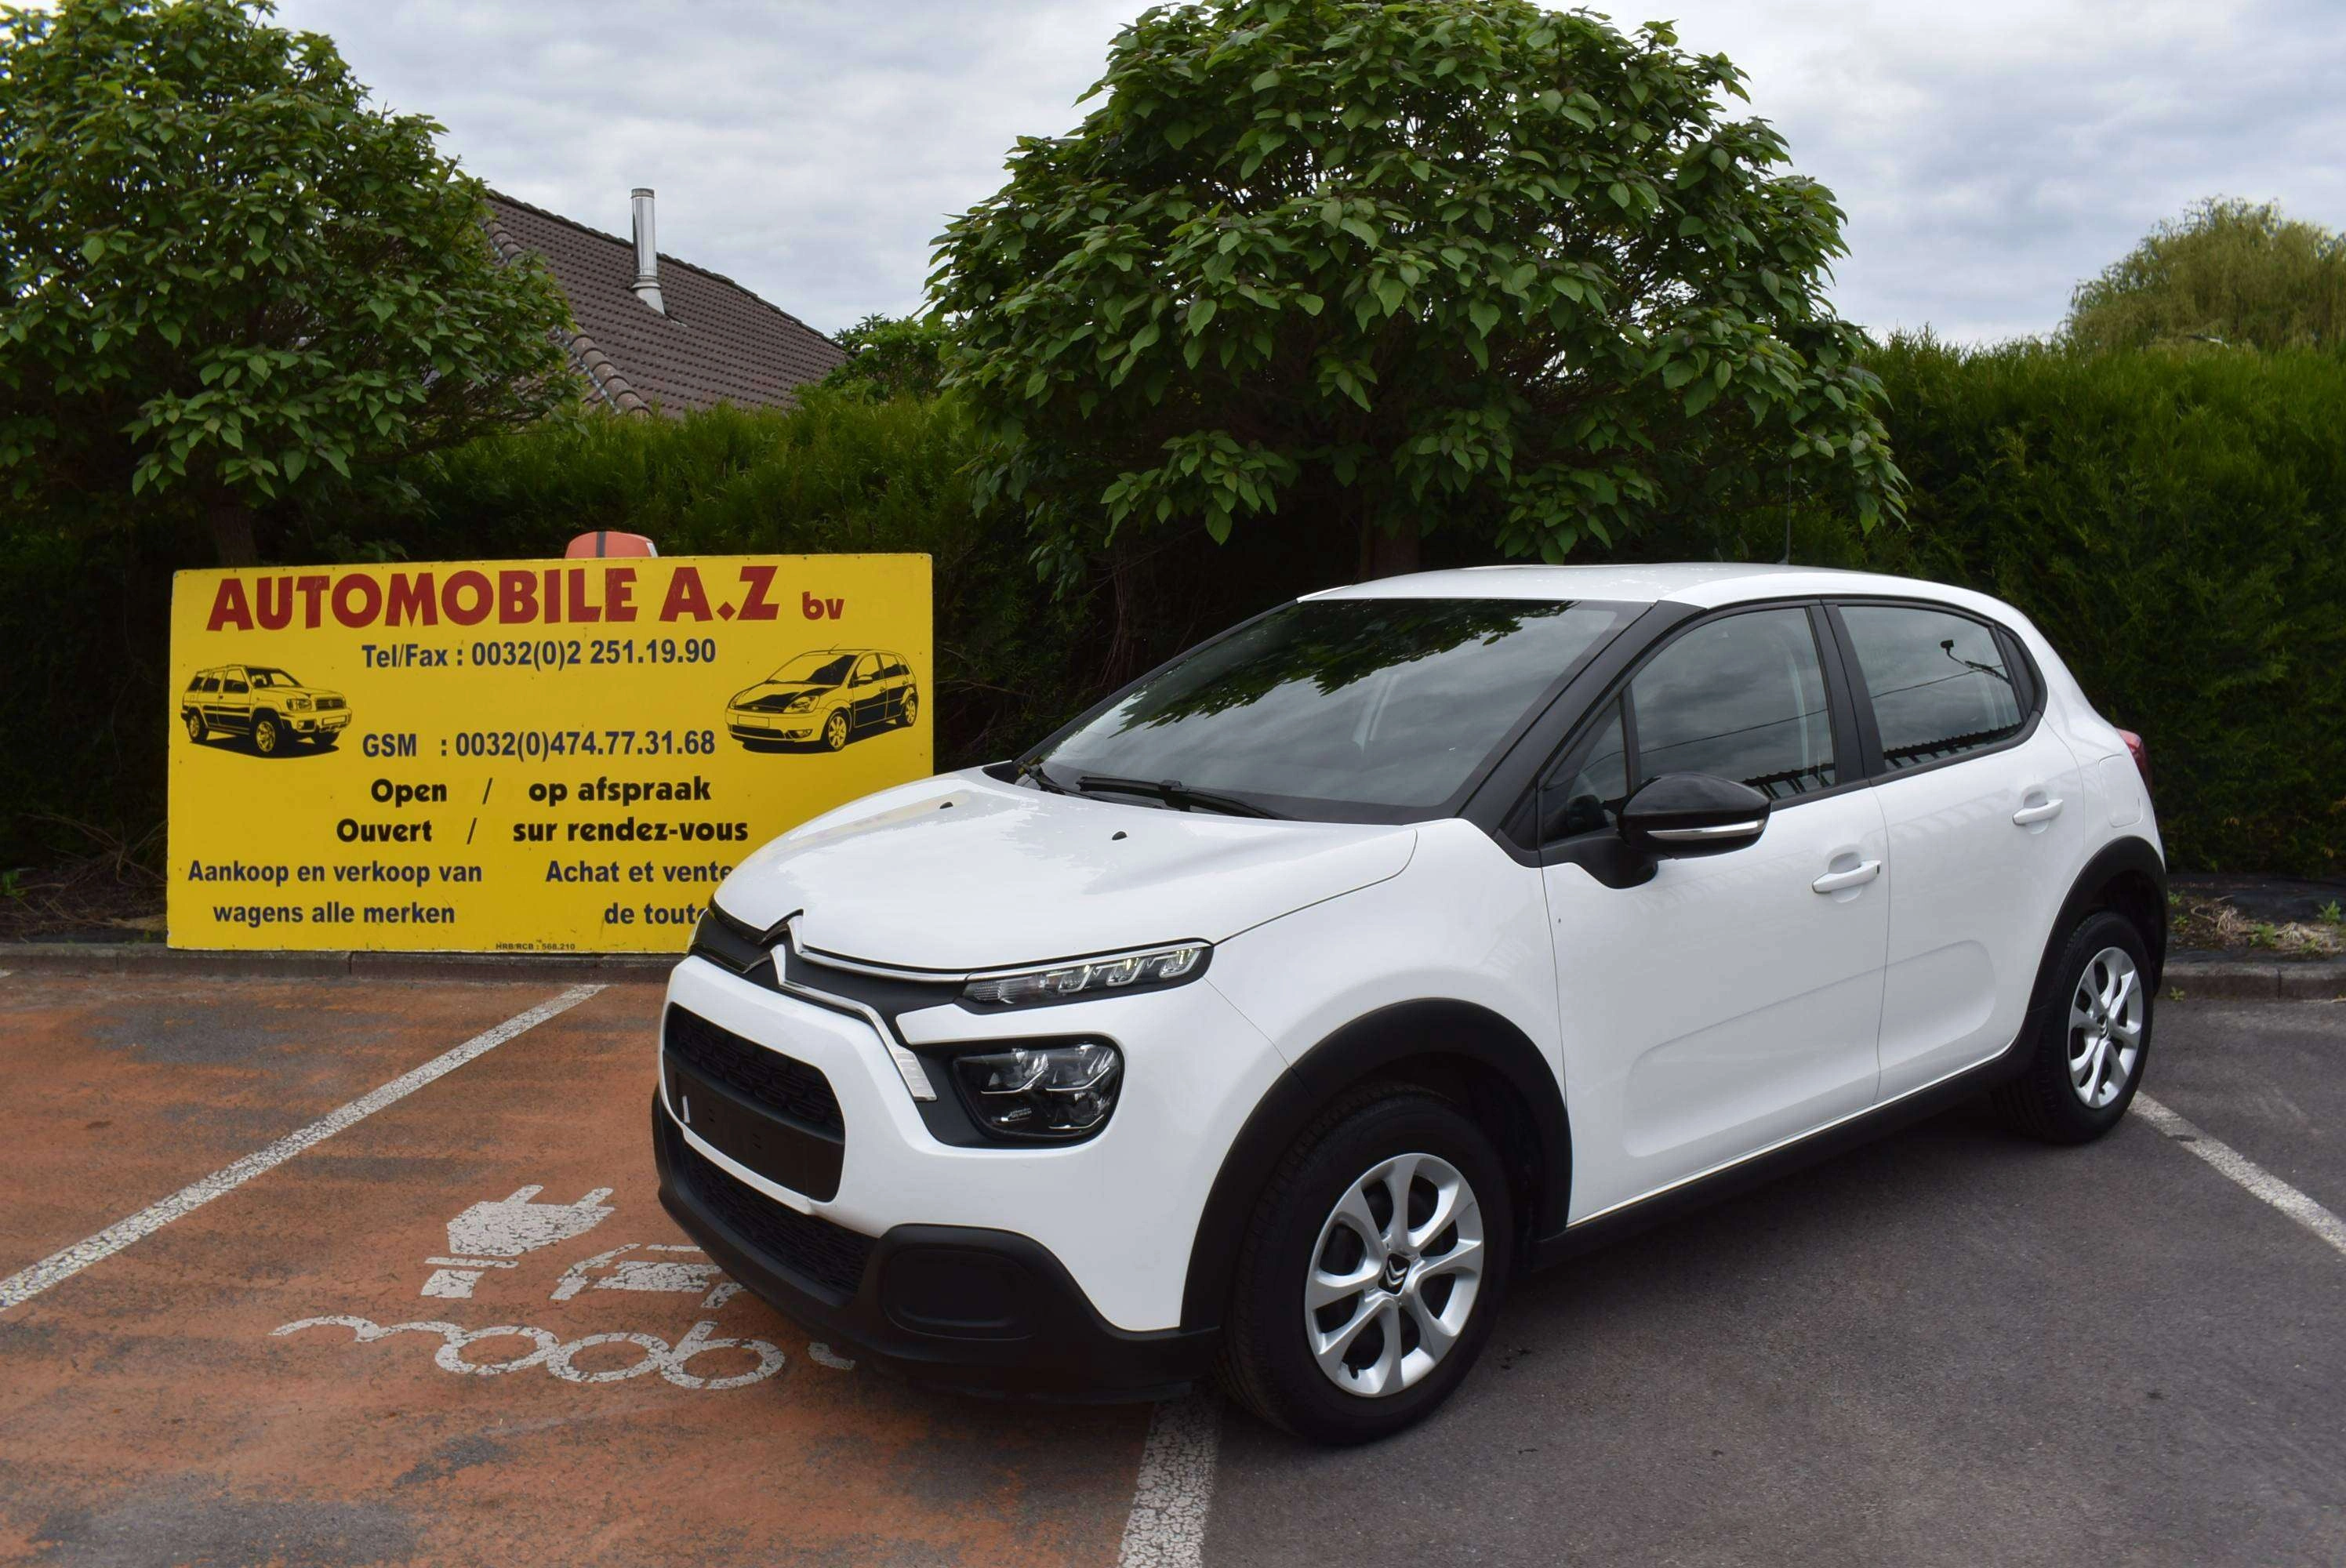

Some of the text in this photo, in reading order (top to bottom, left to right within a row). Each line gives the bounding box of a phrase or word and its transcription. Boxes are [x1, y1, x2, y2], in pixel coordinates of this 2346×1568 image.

[206, 565, 844, 631] AUTOMOBILE A.Z bv
[361, 643, 448, 668] Tel/Fax
[471, 640, 581, 672] 0032(0)2
[590, 638, 716, 664] 251.19.90
[362, 733, 416, 757] GSM
[456, 730, 715, 763] 0032(0)474.77.31.68
[371, 775, 712, 808] Open / op afspraak
[336, 816, 749, 845] Ouvert / sur rendez-vous
[187, 860, 482, 887] Aankoop en verkoop van
[545, 860, 619, 883] Achat
[628, 861, 654, 883] et
[212, 901, 455, 928] wagens alle merken
[604, 902, 635, 924] de
